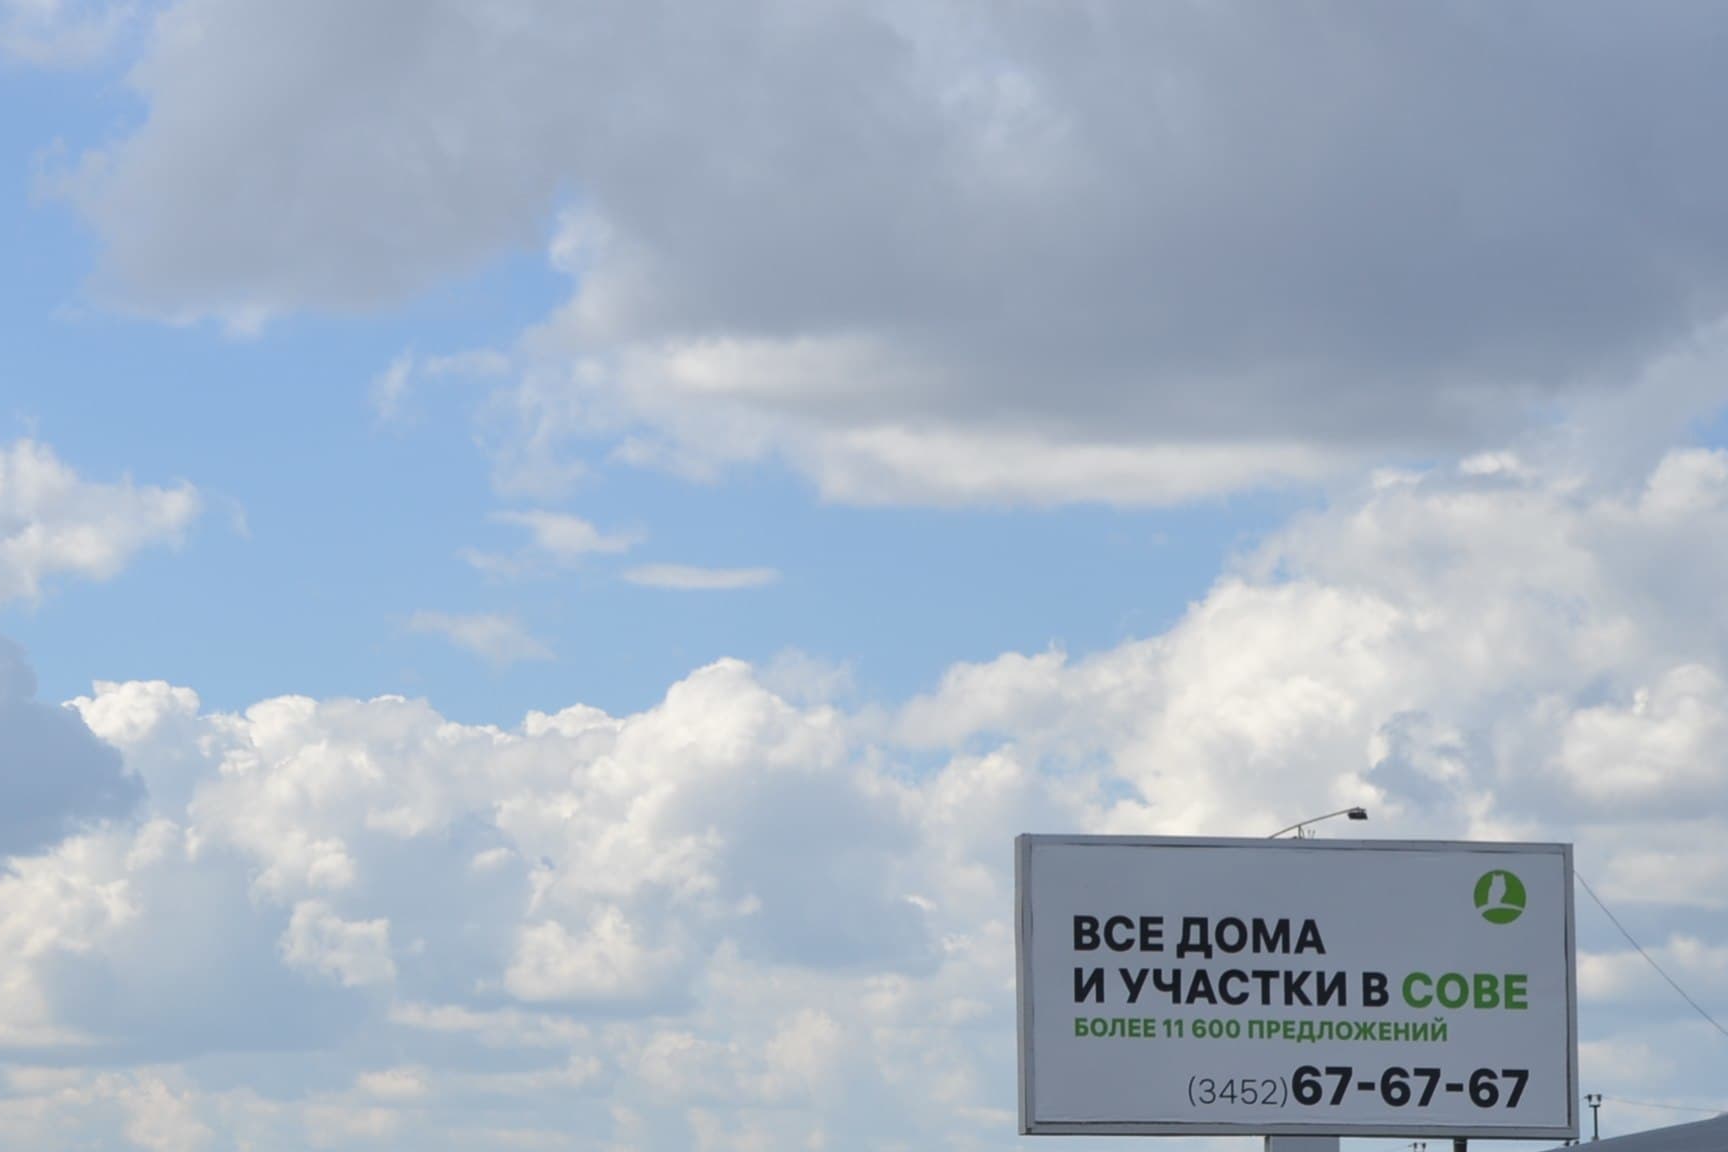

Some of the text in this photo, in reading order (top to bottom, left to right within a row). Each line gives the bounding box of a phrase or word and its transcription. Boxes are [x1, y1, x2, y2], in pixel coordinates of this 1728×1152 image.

[1073, 915, 1326, 959] ВСЕ ДОМА
[1074, 968, 1528, 1010] И УЧАСТКИ В СОВЕ
[1074, 1017, 1448, 1043] БОЛЕЕ 11 600 ПРЕДЛОЖЕНИЙ
[1291, 1065, 1530, 1108] 67-67-67
